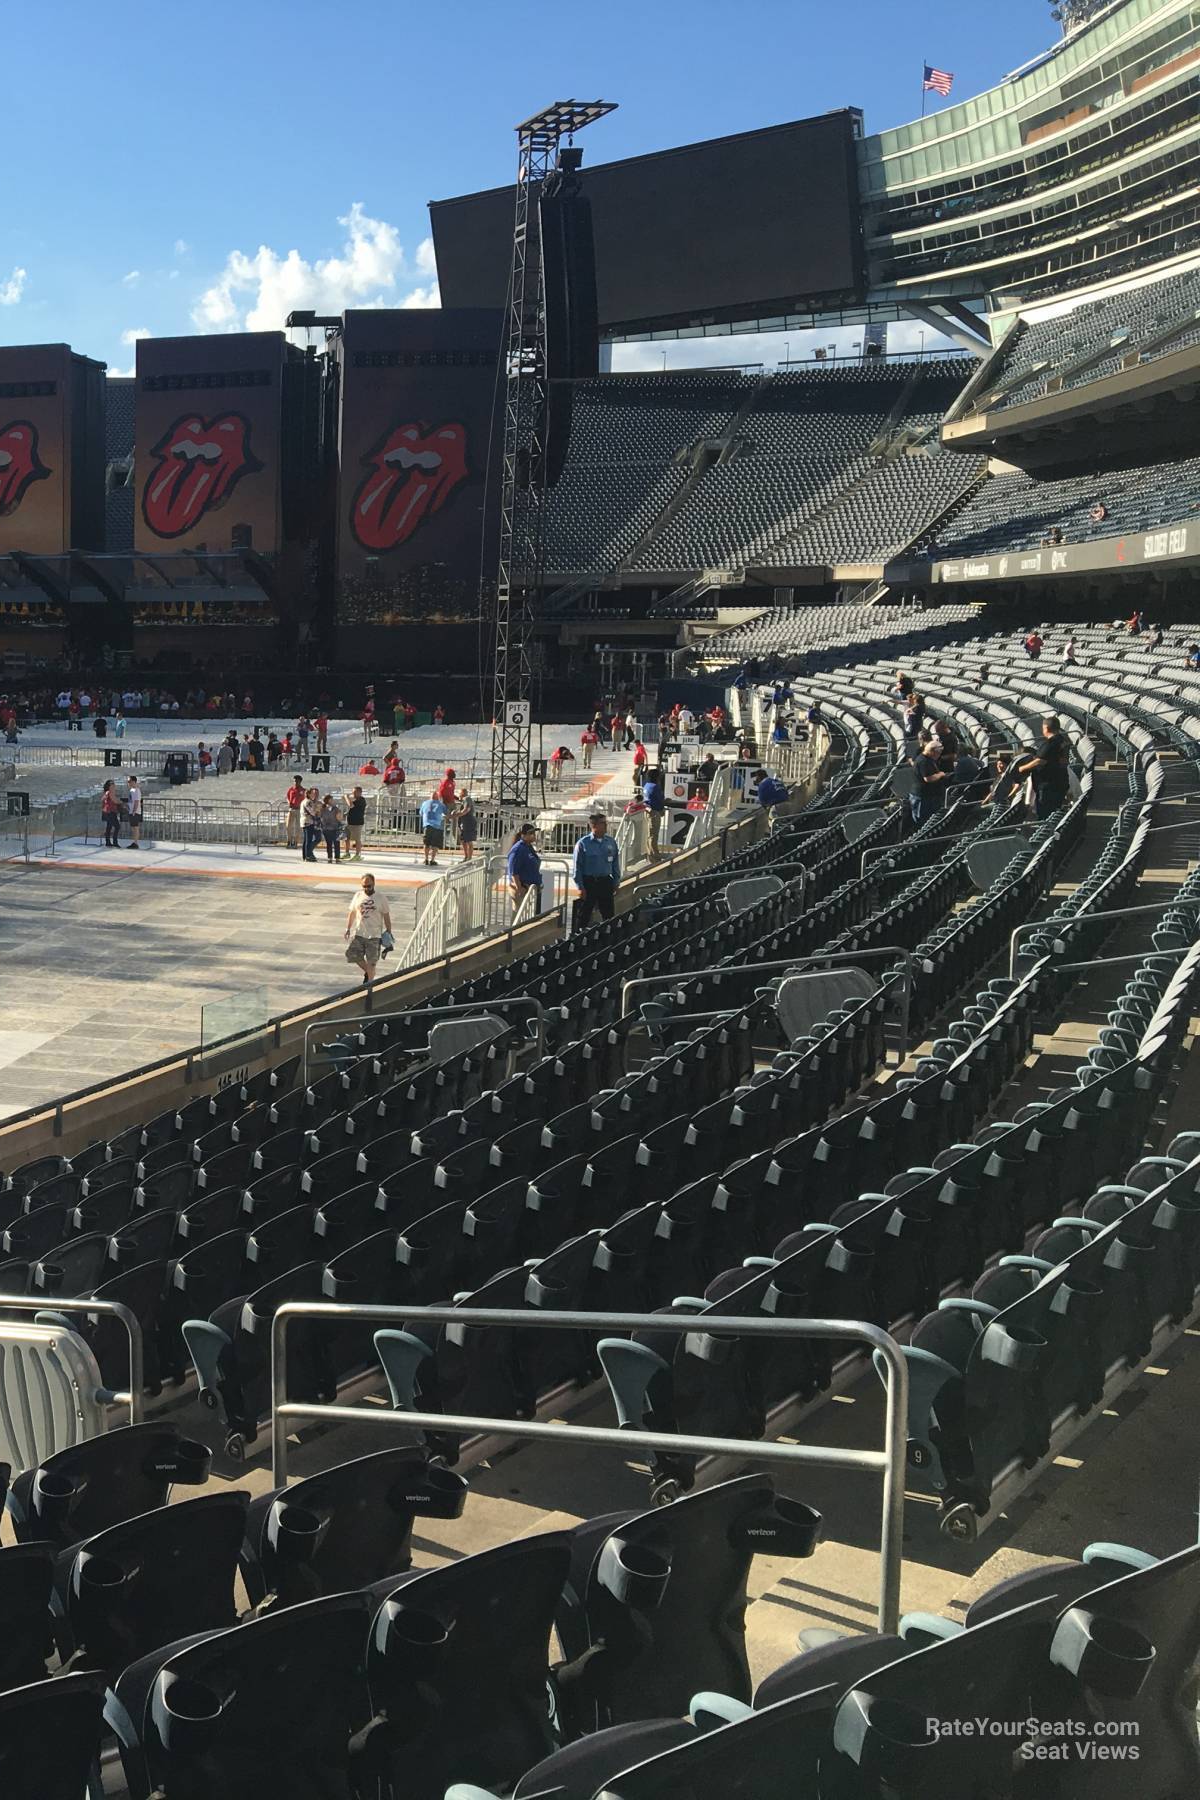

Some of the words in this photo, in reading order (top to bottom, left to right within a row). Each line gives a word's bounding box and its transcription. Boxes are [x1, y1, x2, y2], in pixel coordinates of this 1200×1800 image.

[795, 726, 809, 741] 5
[109, 753, 116, 763] F
[316, 761, 325, 770] A
[536, 764, 542, 775] A
[671, 813, 694, 844] 2
[915, 1451, 922, 1463] 9
[405, 1494, 431, 1503] verizon
[747, 1527, 776, 1537] verizon
